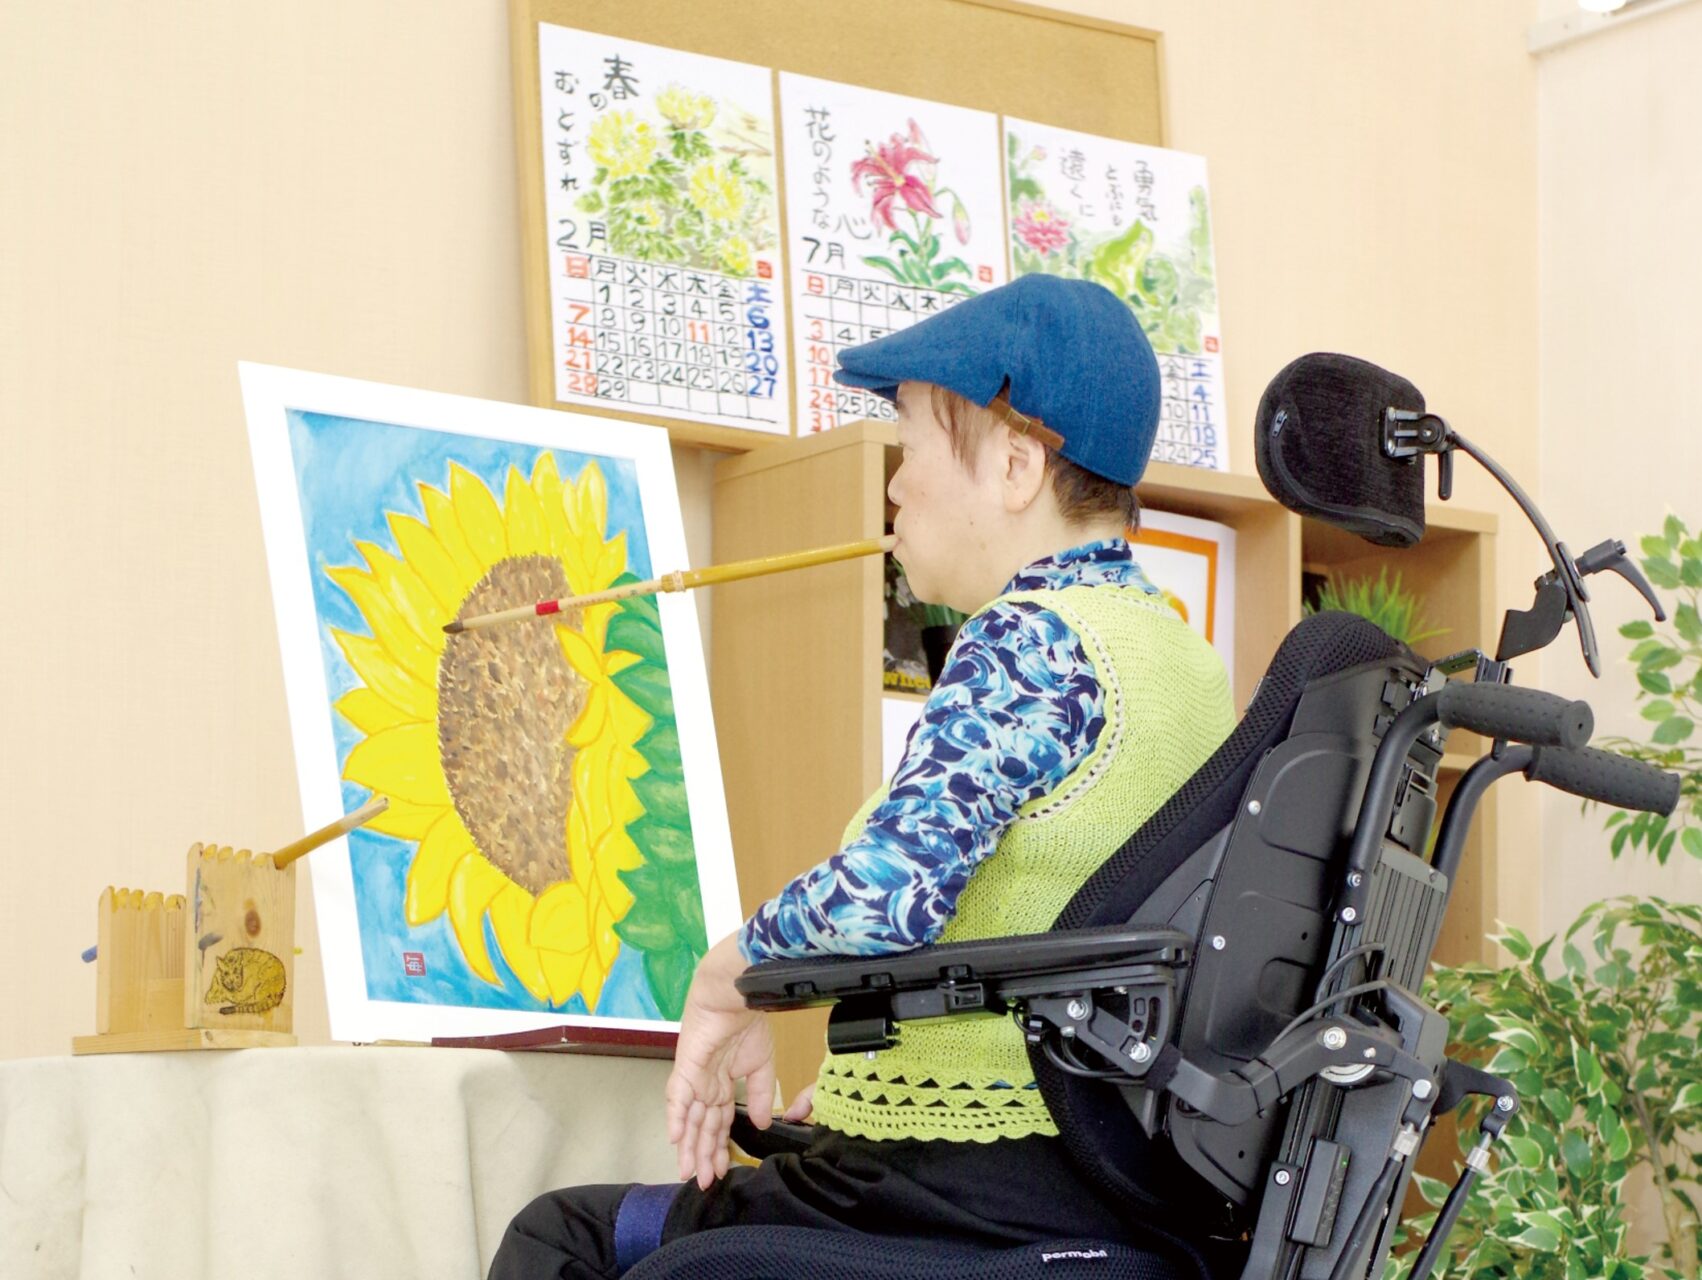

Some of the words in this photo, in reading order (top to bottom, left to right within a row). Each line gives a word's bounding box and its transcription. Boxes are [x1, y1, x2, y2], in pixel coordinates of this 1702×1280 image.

[557, 218, 607, 252] 2月
[802, 237, 846, 270] 7月
[566, 256, 589, 278] 日
[595, 260, 617, 281] 月
[628, 264, 649, 286] 火
[657, 270, 679, 290] 水
[687, 275, 709, 295] 木
[807, 276, 825, 293] 日
[834, 280, 854, 297] 月
[864, 284, 881, 301] 火
[892, 291, 910, 311] 水
[920, 295, 938, 310] 木
[599, 285, 610, 304] 1
[630, 290, 645, 309] 2
[663, 295, 676, 315] 3
[691, 299, 706, 319] 4
[719, 303, 735, 322] 5
[748, 307, 769, 329] 6
[568, 305, 590, 323] 7
[600, 309, 616, 327] 8
[630, 312, 646, 332] 9
[660, 317, 681, 337] 10
[688, 322, 710, 343] 11
[718, 326, 739, 345] 12
[748, 331, 774, 352] 13
[810, 320, 823, 340] 3
[837, 327, 856, 341] 4
[568, 328, 593, 347] 14
[598, 332, 620, 352] 15
[630, 336, 651, 357] 16
[658, 341, 681, 360] 17
[690, 345, 712, 365] 18
[719, 349, 742, 368] 19
[746, 354, 778, 376] 20
[809, 345, 831, 365] 10
[566, 351, 591, 369] 21
[598, 355, 624, 375] 22
[630, 359, 655, 380] 23
[660, 364, 685, 385] 24
[690, 368, 715, 390] 25
[719, 372, 744, 394] 26
[748, 378, 776, 398] 27
[568, 374, 597, 394] 28
[600, 379, 626, 398] 29
[809, 367, 832, 386] 17
[809, 391, 835, 410] 24
[837, 394, 861, 415] 25
[866, 398, 892, 418] 26
[1193, 384, 1209, 400] 4
[1166, 403, 1185, 421] 10
[1192, 405, 1211, 422] 11
[1168, 425, 1186, 441] 17
[1194, 426, 1217, 446] 18
[1166, 446, 1187, 463] 24
[1193, 448, 1218, 469] 25
[1042, 1249, 1108, 1263] permobil
